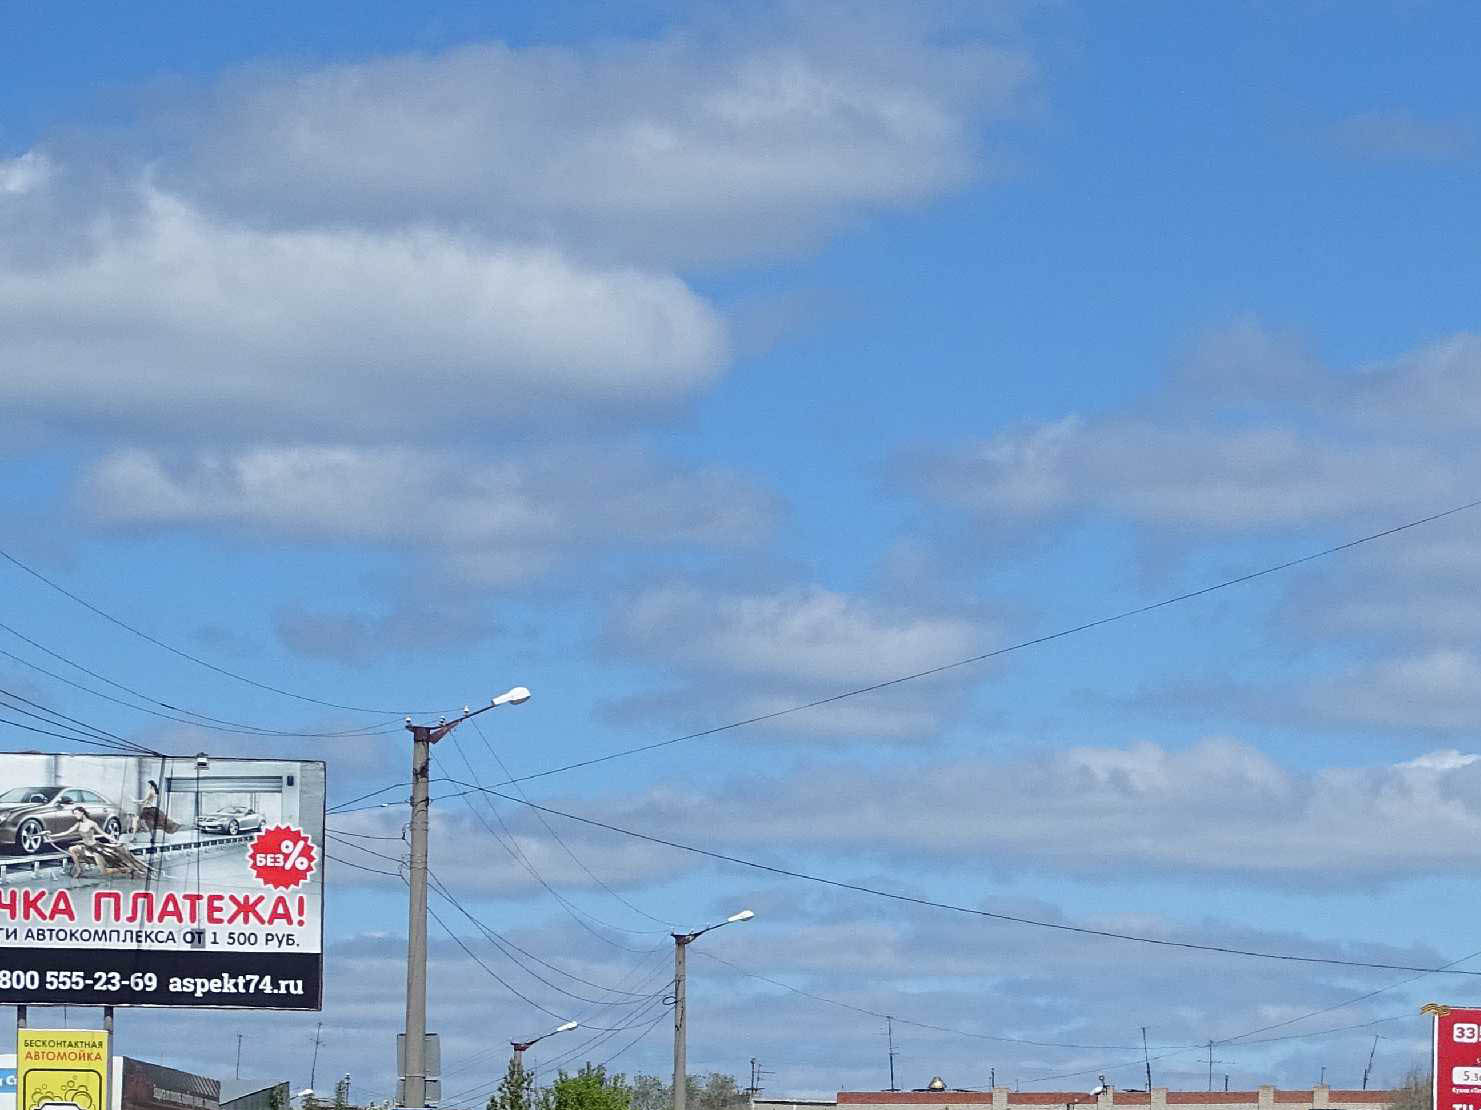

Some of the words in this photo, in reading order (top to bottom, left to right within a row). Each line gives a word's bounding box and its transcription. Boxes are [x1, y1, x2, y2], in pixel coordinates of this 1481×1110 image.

[256, 854, 283, 867] БЕЗ
[94, 891, 305, 927] ПЛАТЕЖА!
[0, 928, 18, 940] И
[24, 928, 177, 945] АВТОКОМПЛЕКСА
[183, 931, 204, 945] ОТ
[210, 932, 220, 945] 1
[227, 932, 258, 946] 500
[265, 933, 300, 949] РУБ.
[0, 970, 40, 990] 800
[45, 971, 158, 992] 555-23-69
[168, 973, 304, 997] aspekt74.ru
[1455, 1026, 1476, 1040] 33
[24, 1039, 104, 1049] БЕСКОНТАКТНАЯ
[25, 1050, 103, 1061] АВТОМОЙКА
